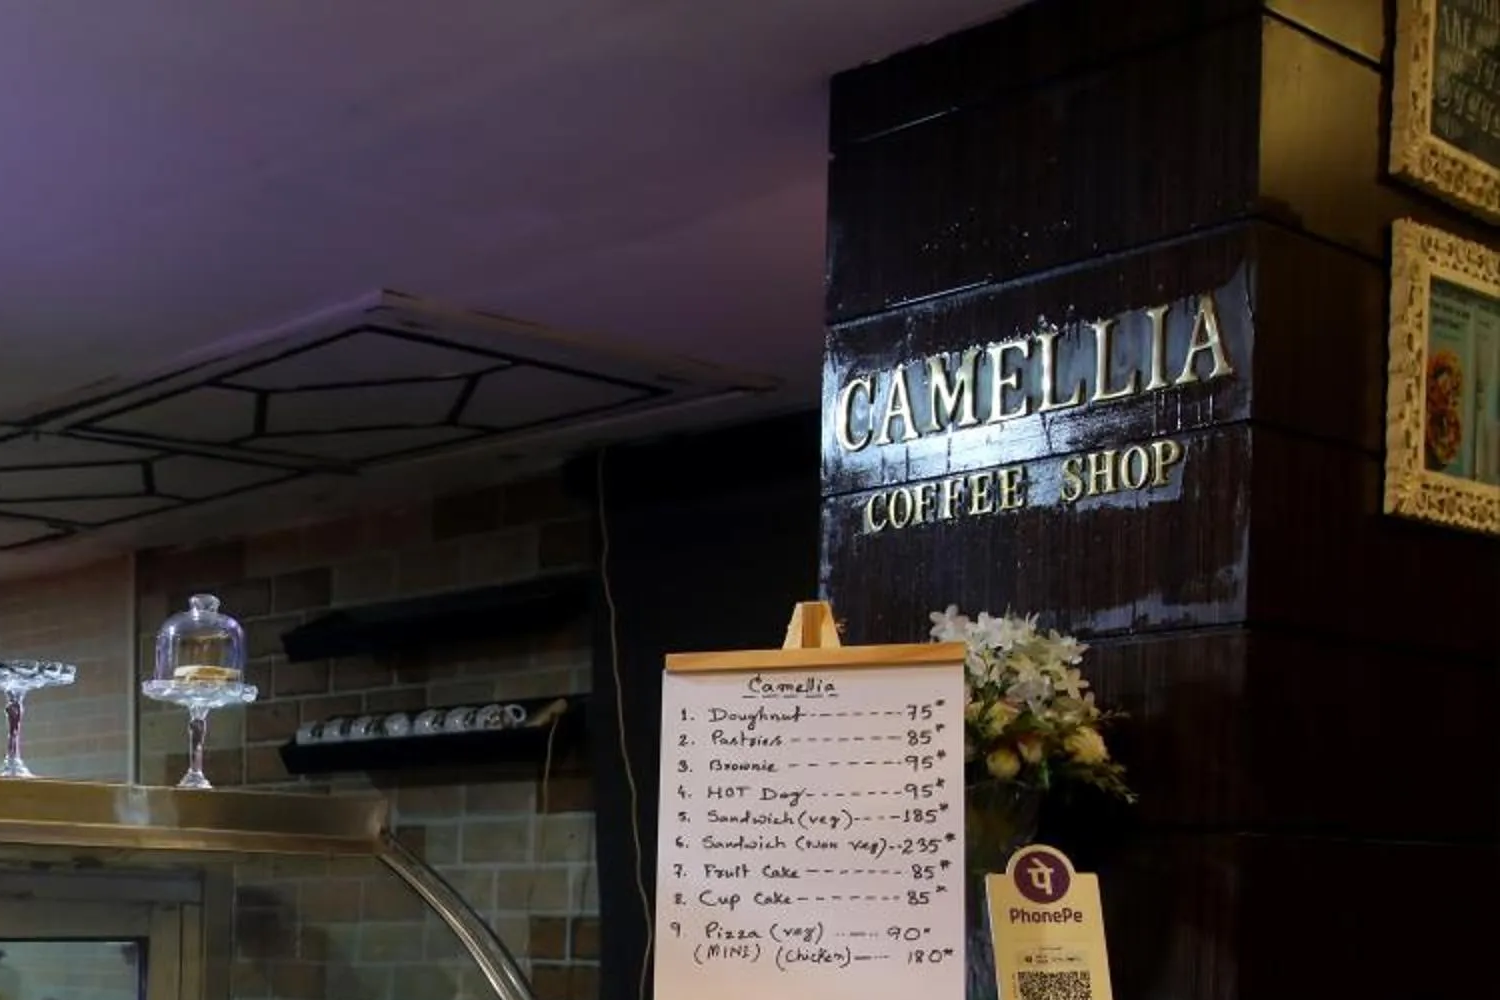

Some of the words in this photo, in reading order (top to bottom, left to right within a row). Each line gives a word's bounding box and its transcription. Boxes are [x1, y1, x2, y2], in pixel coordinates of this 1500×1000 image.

[836, 293, 1234, 453] CAMELLIA
[862, 465, 1028, 534] COFFEE
[1060, 439, 1185, 502] SHOP
[747, 674, 836, 694] Camellia
[708, 705, 805, 731] Doughnut
[709, 759, 779, 773] Brownie
[707, 785, 751, 800] HOT
[759, 787, 806, 807] Dog
[702, 834, 786, 851] Sandwich
[704, 863, 750, 879] Fruit
[761, 864, 800, 879] Cake
[699, 889, 741, 911] Cup
[753, 891, 793, 906] Cake
[1008, 907, 1083, 925] PhonePe
[705, 921, 763, 939] Pizza
